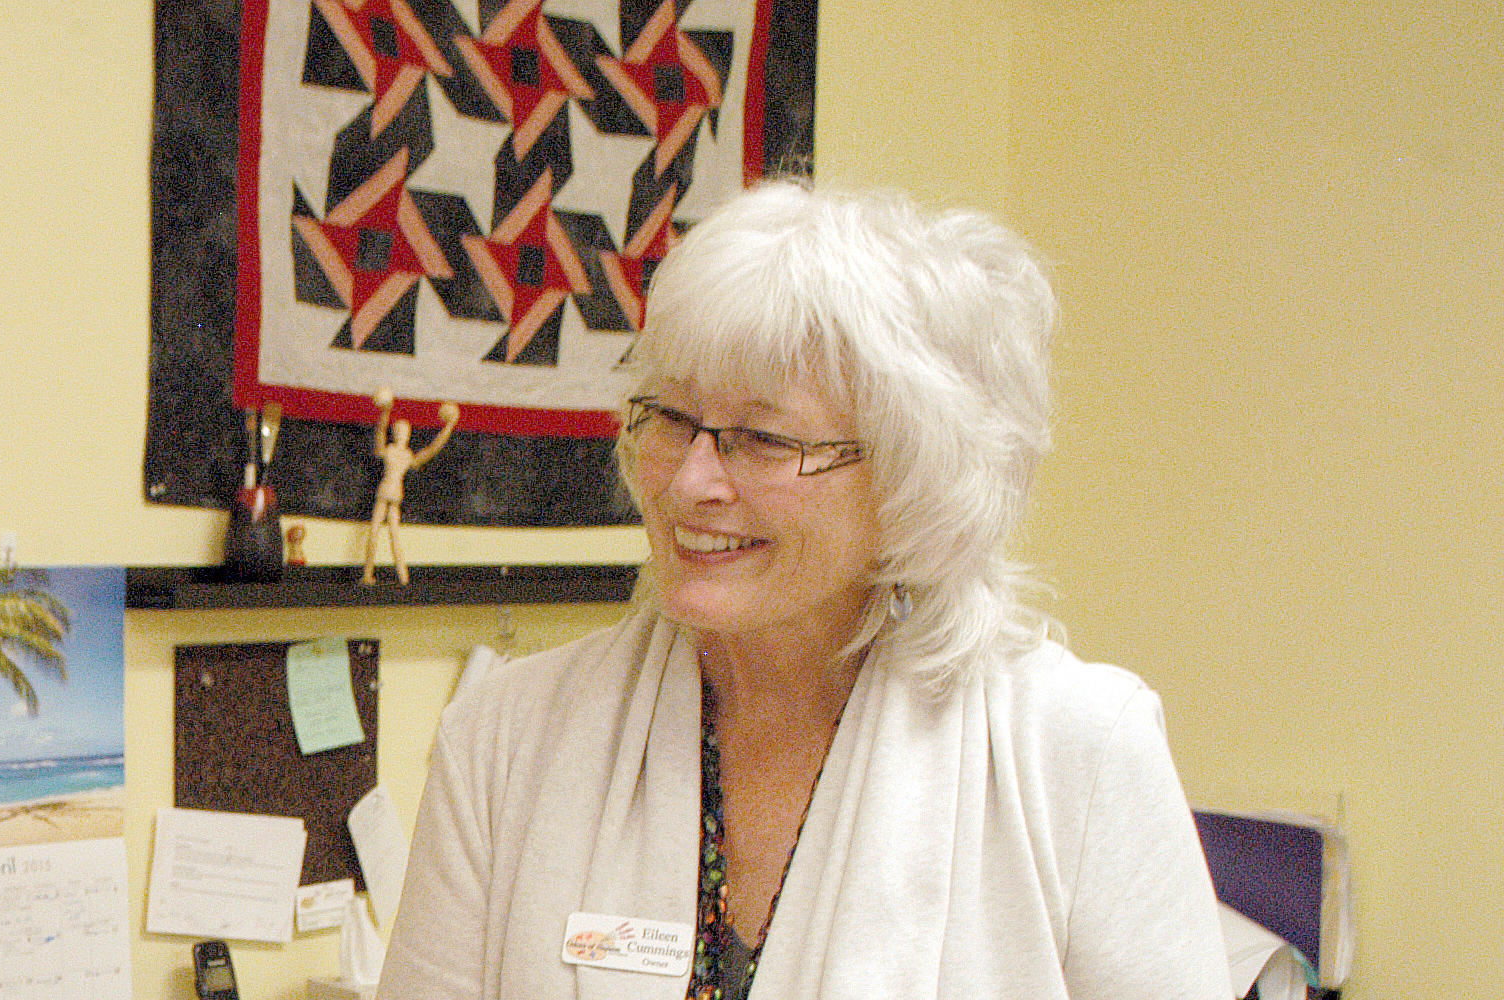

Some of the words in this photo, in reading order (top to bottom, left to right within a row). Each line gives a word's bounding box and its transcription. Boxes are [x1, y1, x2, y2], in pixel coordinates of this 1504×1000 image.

[642, 928, 679, 943] Eileen
[627, 940, 690, 960] Cummings
[642, 958, 669, 968] Owner
